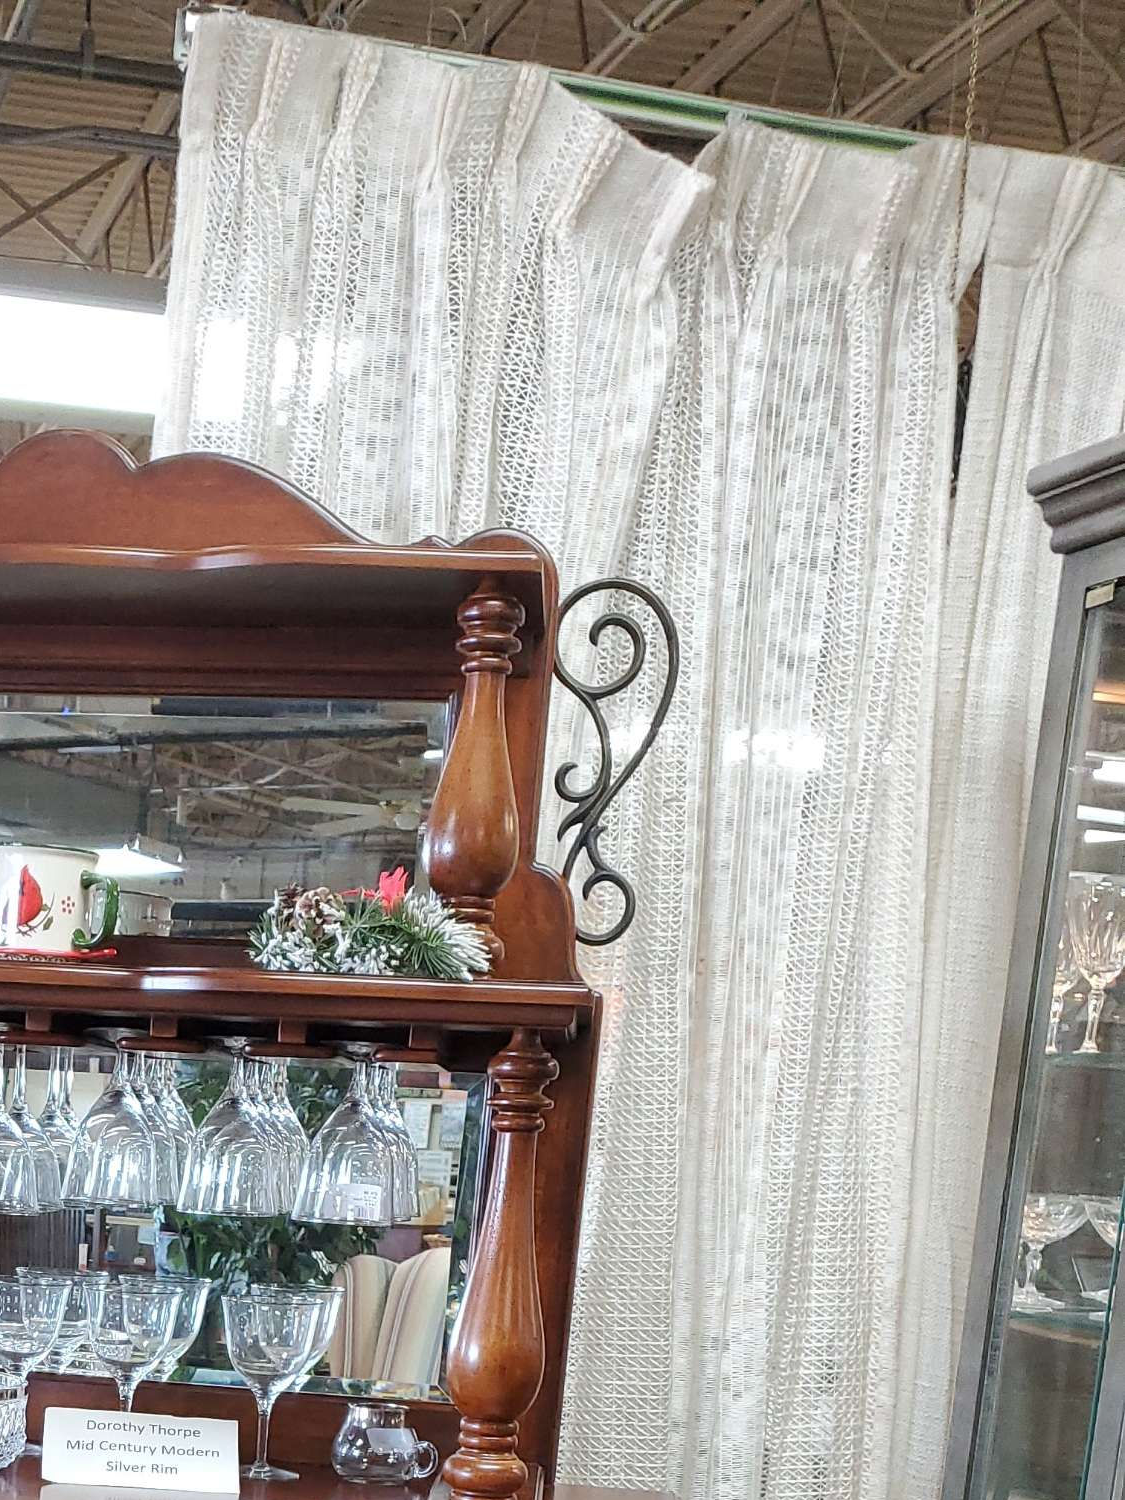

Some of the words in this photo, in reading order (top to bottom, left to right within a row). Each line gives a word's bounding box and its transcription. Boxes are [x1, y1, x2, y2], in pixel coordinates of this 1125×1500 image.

[86, 1419, 145, 1435] Dorothy
[149, 1423, 201, 1438] Thorpe
[66, 1439, 94, 1451] Mid
[99, 1440, 157, 1456] Century
[161, 1445, 220, 1458] Modern
[106, 1461, 146, 1473] Silver
[151, 1463, 178, 1475] Rim
